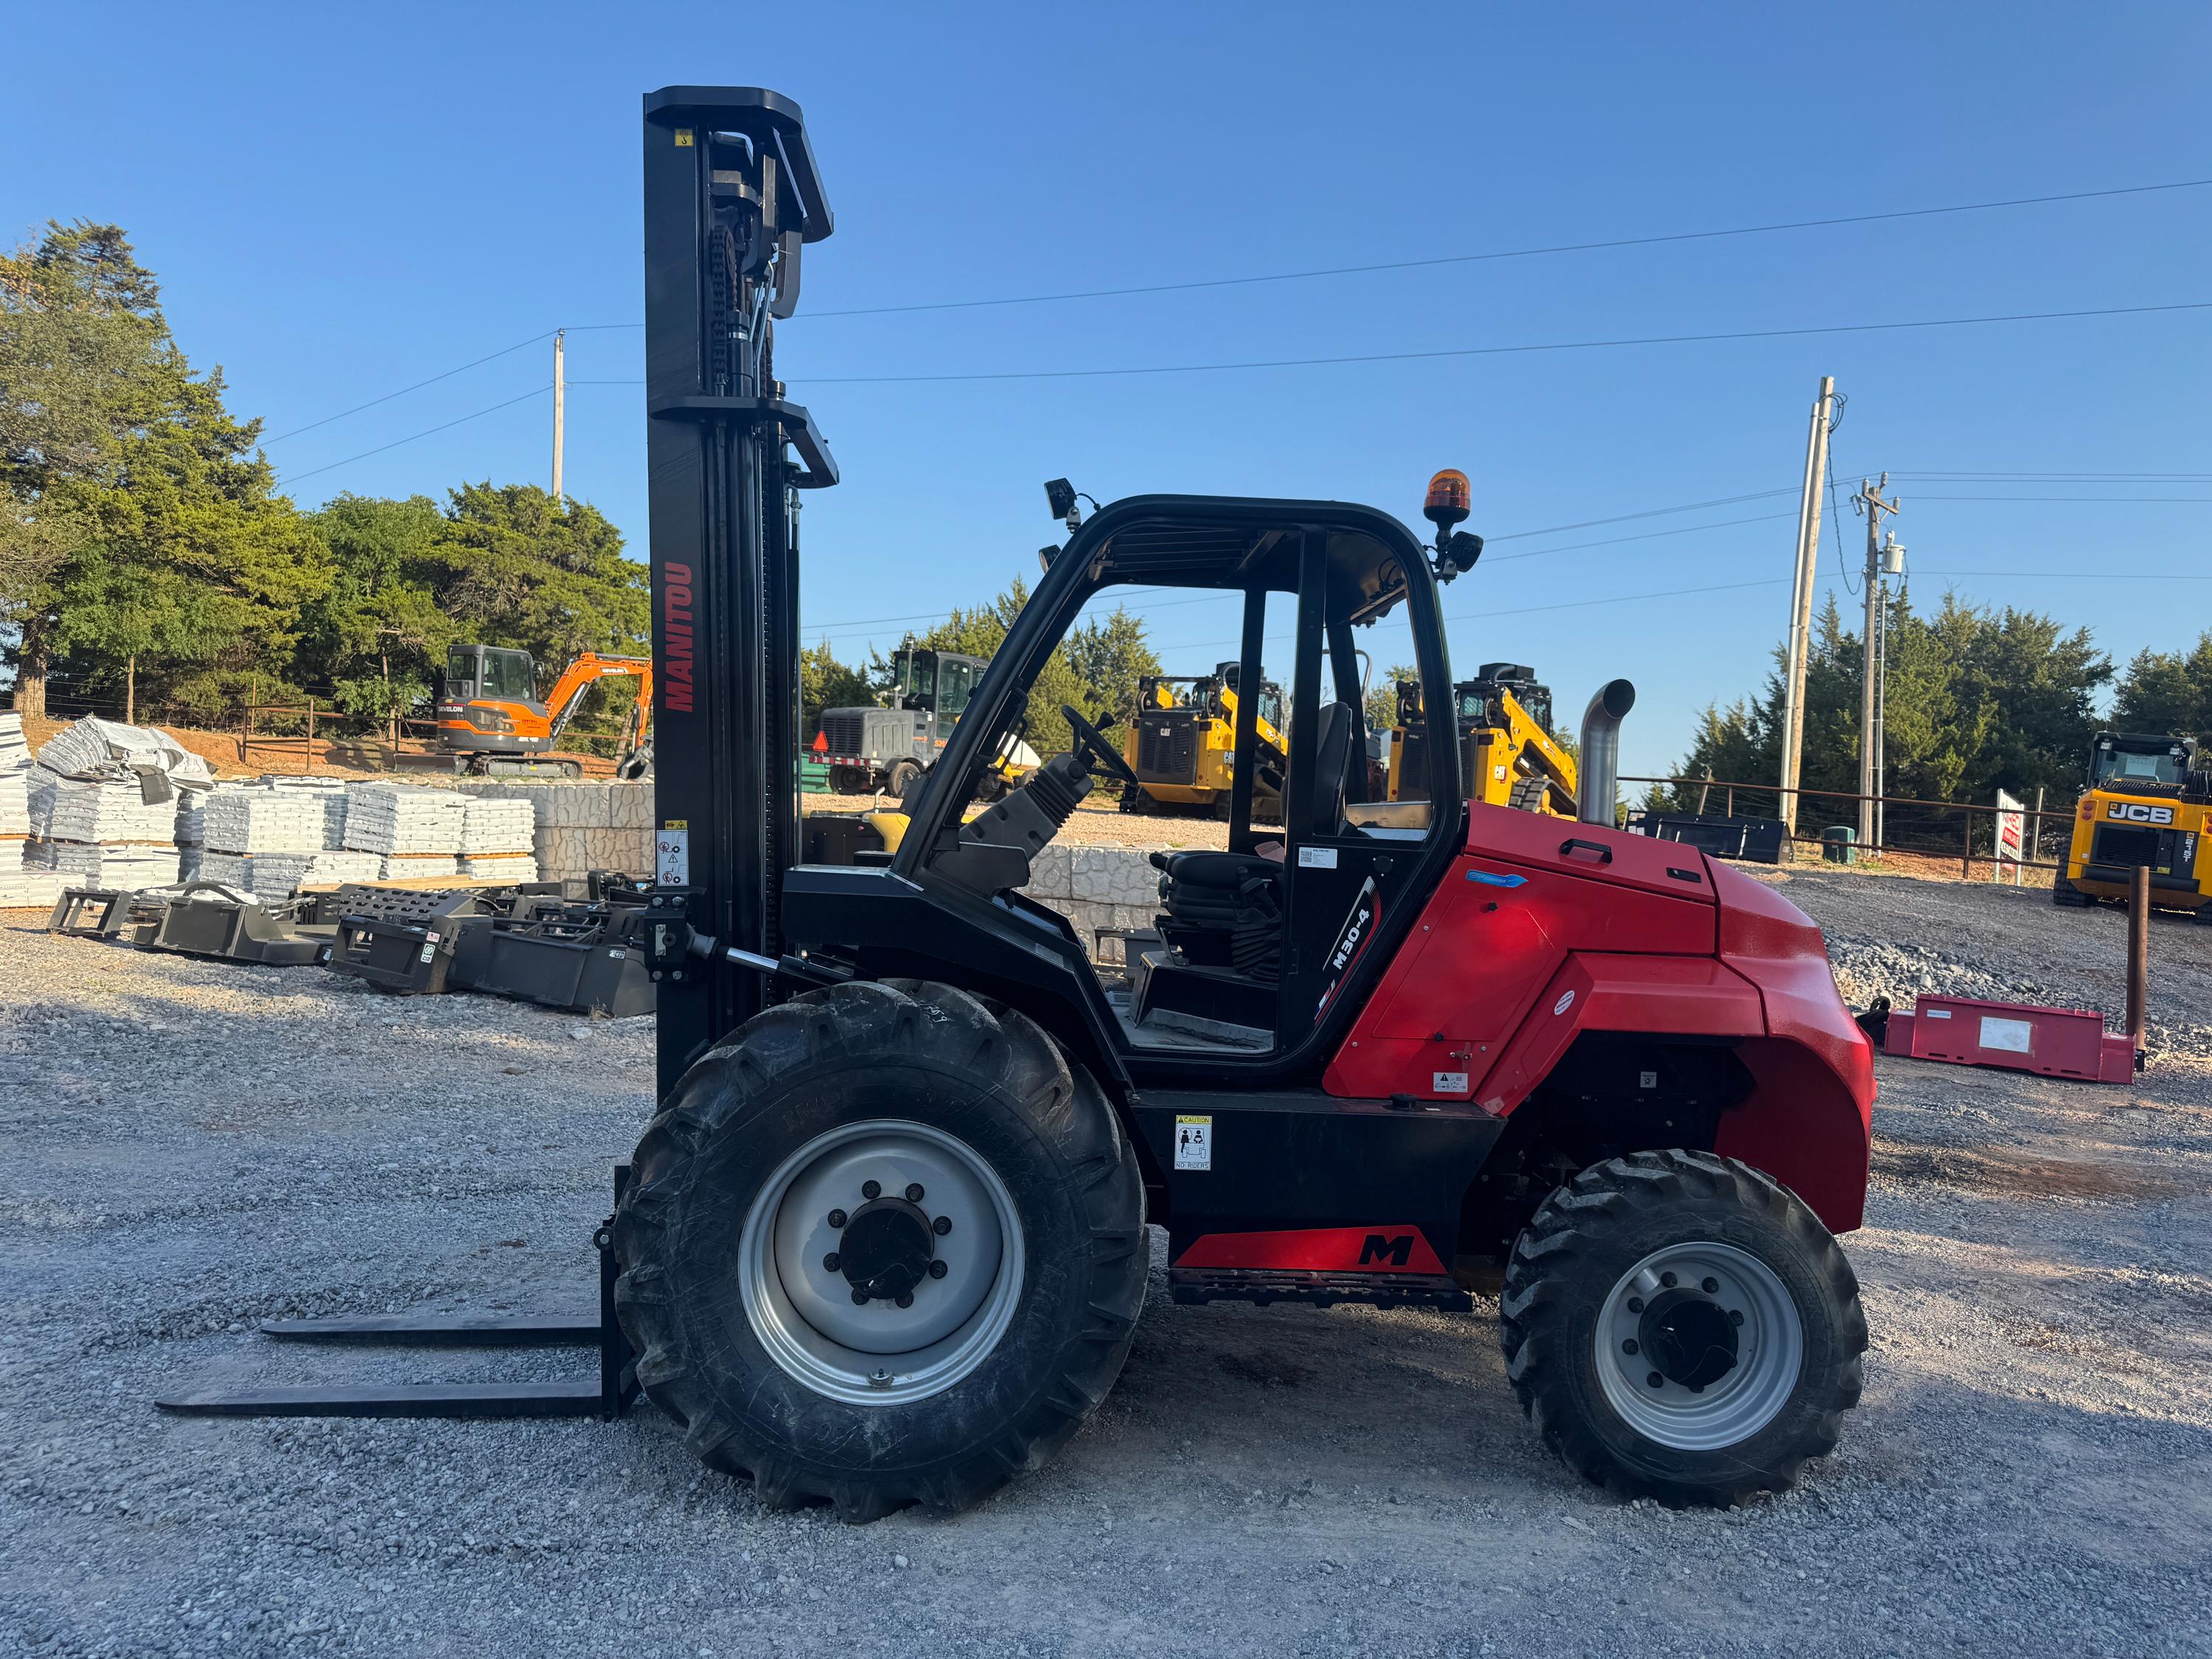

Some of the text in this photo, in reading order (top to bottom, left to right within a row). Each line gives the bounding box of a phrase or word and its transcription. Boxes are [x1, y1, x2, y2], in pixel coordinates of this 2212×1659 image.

[664, 561, 693, 713] MANITOU
[1160, 727, 1172, 737] CAT
[2108, 803, 2173, 824] JCB
[2183, 838, 2195, 863] 215T
[1332, 908, 1370, 970] M30-4
[1357, 1234, 1415, 1266] M
